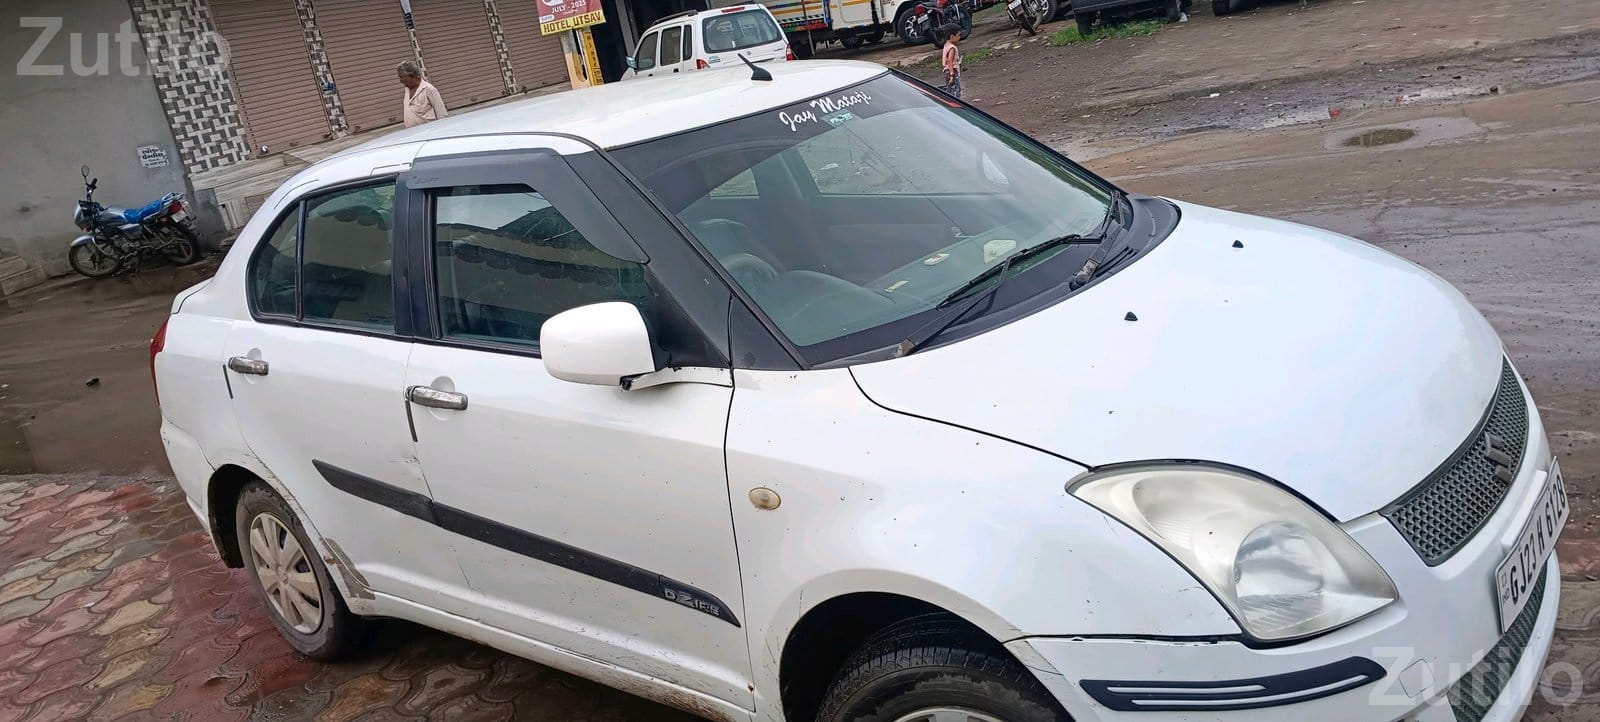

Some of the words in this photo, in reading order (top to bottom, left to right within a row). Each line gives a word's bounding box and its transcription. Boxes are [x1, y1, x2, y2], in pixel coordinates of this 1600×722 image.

[543, 19, 572, 33] HOTEL
[573, 11, 602, 27] UTSAV
[551, 4, 566, 14] JULY
[779, 111, 818, 132] Jay
[809, 91, 872, 114] Mataji
[1510, 532, 1537, 605] GJ23
[1536, 514, 1545, 552] H
[1545, 474, 1566, 538] 6128
